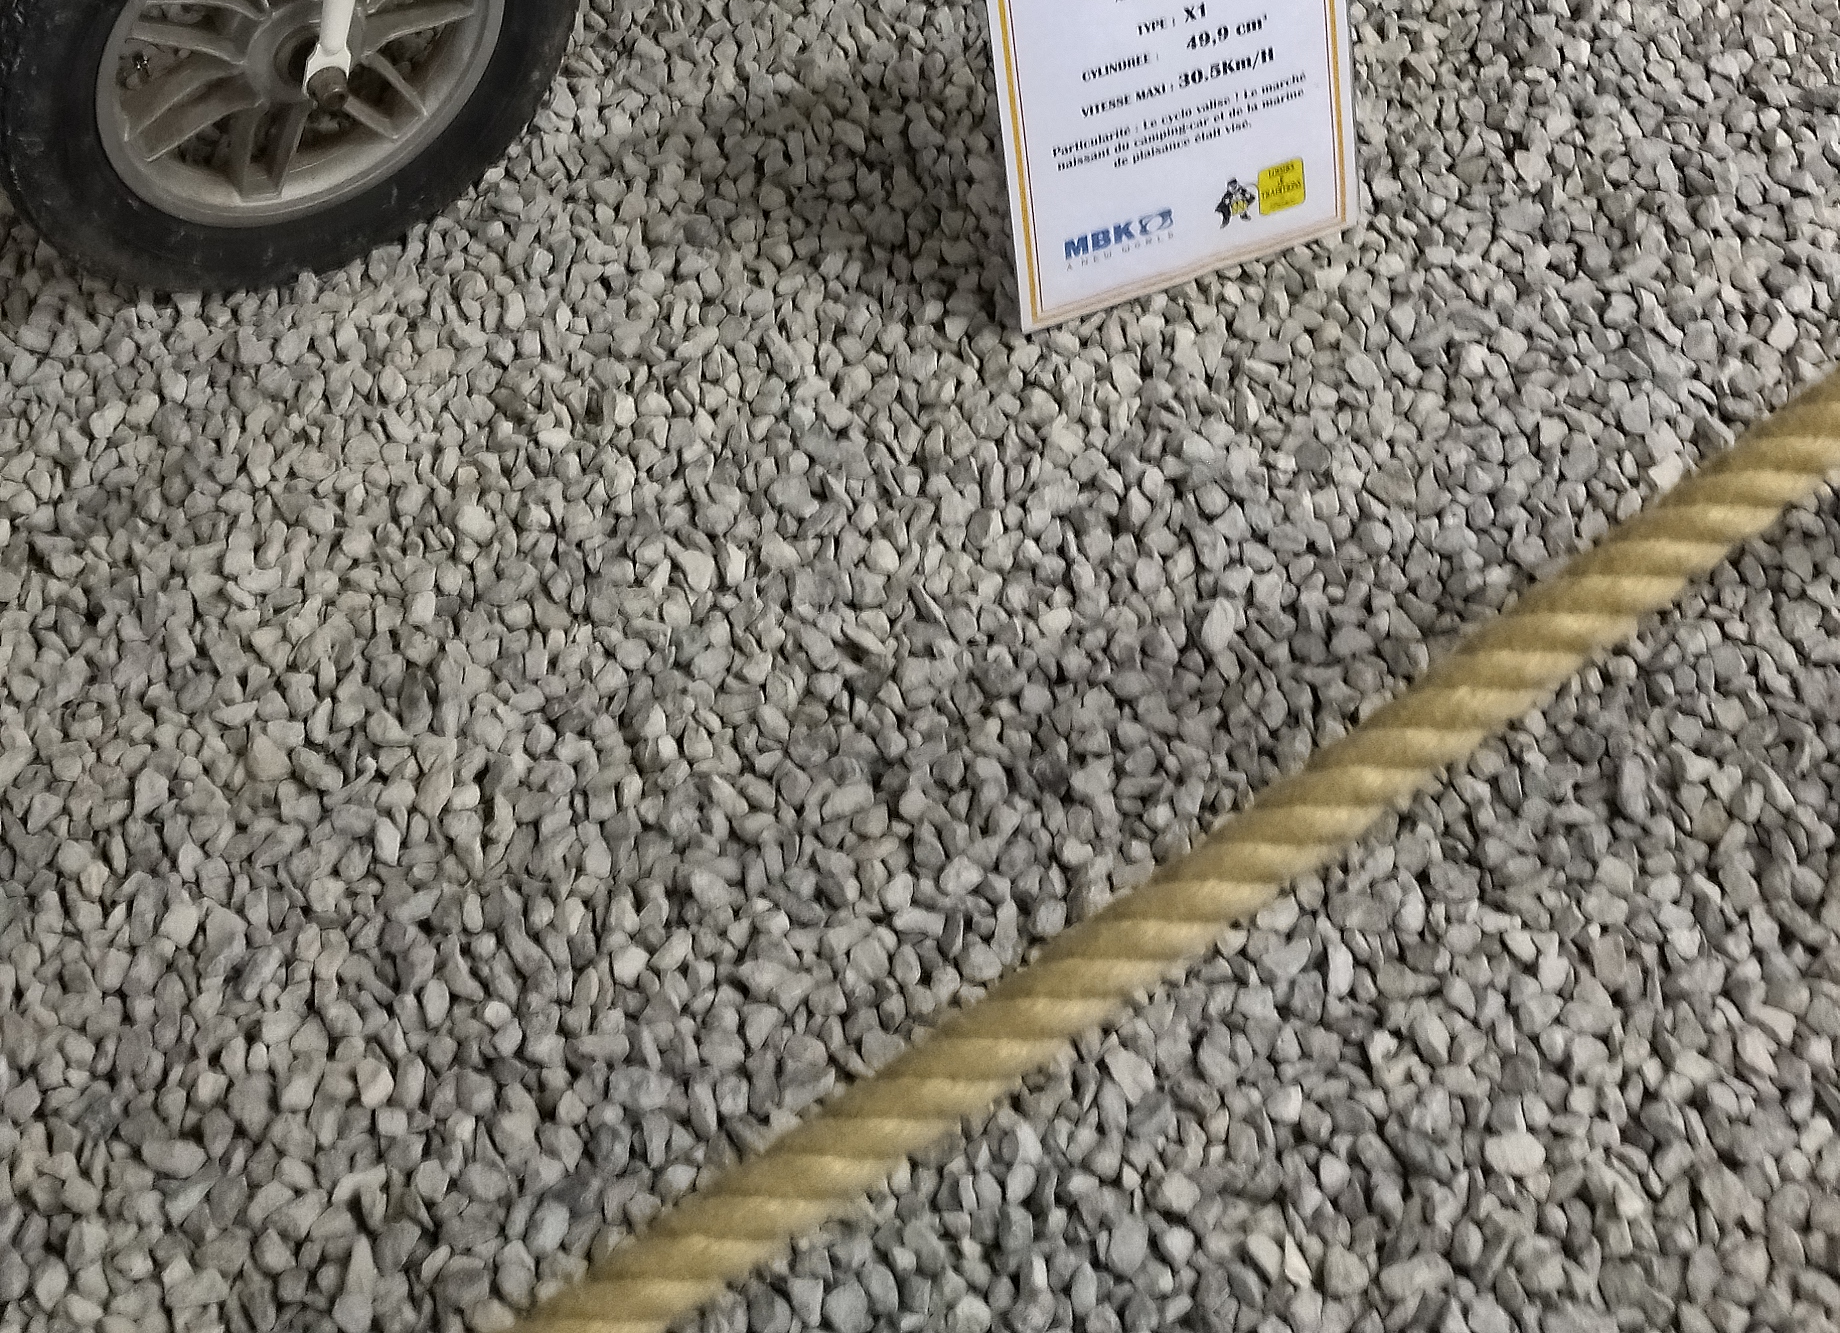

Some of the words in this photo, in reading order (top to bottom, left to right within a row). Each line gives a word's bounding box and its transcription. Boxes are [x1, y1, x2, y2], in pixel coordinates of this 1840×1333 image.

[1136, 18, 1167, 36] TYPE
[1184, 1, 1207, 24] X1
[1186, 25, 1231, 50] 49,9
[1081, 94, 1131, 118] VITESSE
[1135, 82, 1167, 102] MAXI
[1177, 46, 1275, 89] 30.5Km/H
[1142, 118, 1157, 131] Le
[1161, 108, 1192, 124] cyclo
[1196, 97, 1230, 114] valise
[1243, 88, 1258, 100] Le
[1261, 70, 1306, 94] marché
[1057, 147, 1110, 172] naissant
[1113, 142, 1130, 154] du
[1213, 111, 1224, 123] et
[1228, 106, 1243, 118] de
[1246, 102, 1258, 114] la
[1261, 89, 1304, 109] marine
[1113, 156, 1129, 168] de
[1132, 138, 1191, 164] plaisance
[1063, 219, 1135, 261] MBK
[1066, 263, 1073, 272] A
